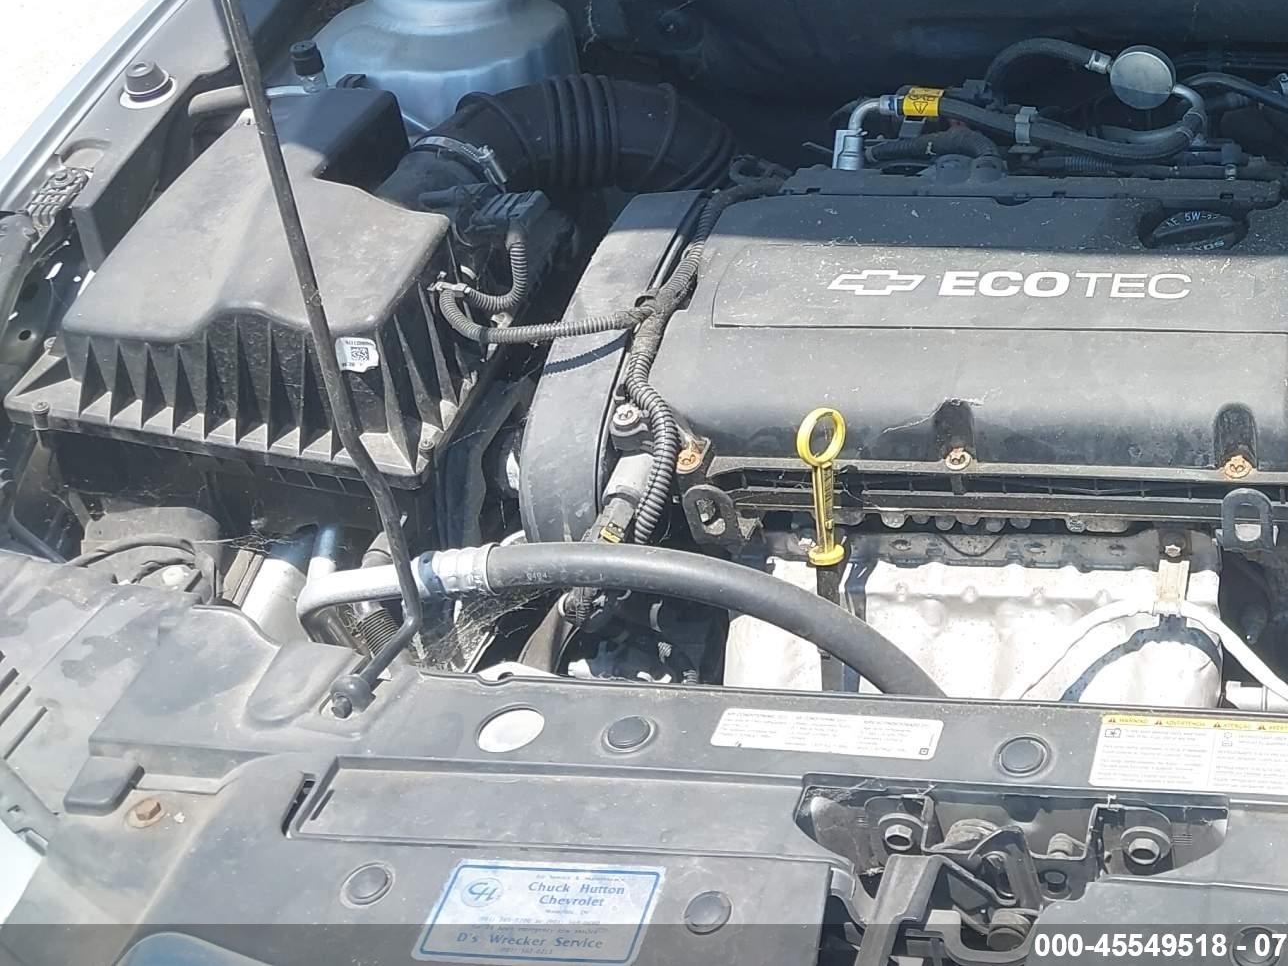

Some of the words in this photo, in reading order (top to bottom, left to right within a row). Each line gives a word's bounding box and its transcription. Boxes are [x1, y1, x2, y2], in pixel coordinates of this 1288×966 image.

[938, 271, 1192, 299] ECOTEC
[528, 881, 571, 893] Chuck
[579, 882, 626, 895] Hutton
[539, 895, 605, 907] Chevrolet
[456, 932, 479, 944] D's
[489, 933, 546, 947] Wrecker
[554, 936, 604, 949] Service
